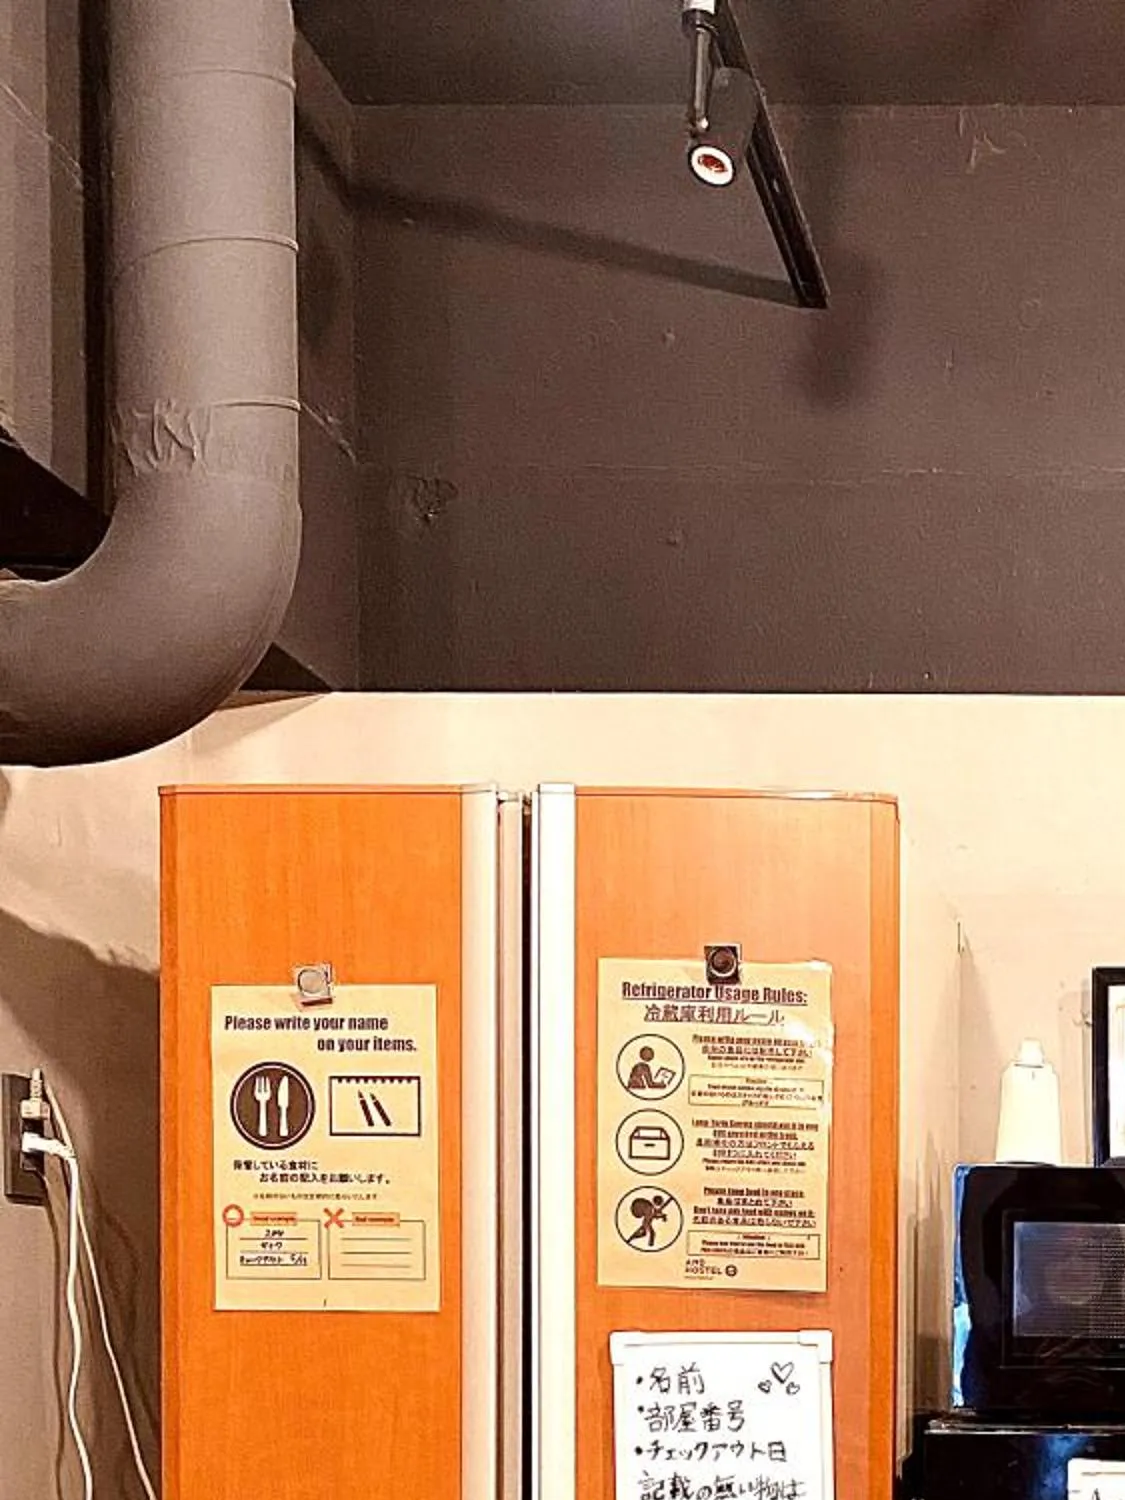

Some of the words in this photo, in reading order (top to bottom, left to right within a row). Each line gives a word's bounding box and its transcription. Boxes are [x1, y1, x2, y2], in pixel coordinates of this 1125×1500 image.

[622, 981, 712, 1000] Refrigerator
[715, 985, 760, 1002] Usage
[763, 987, 808, 1003] Rules:
[224, 1015, 271, 1030] Please
[274, 1015, 311, 1030] write
[313, 1017, 345, 1031] your
[348, 1017, 389, 1030] name
[644, 1003, 785, 1025] 冷蔵庫利用ルール
[317, 1038, 335, 1051] on
[338, 1037, 371, 1052] your
[373, 1036, 417, 1051] items.
[650, 1362, 706, 1395] 名前
[644, 1399, 746, 1433] 部屋番号
[646, 1439, 788, 1462] チェックアウト日
